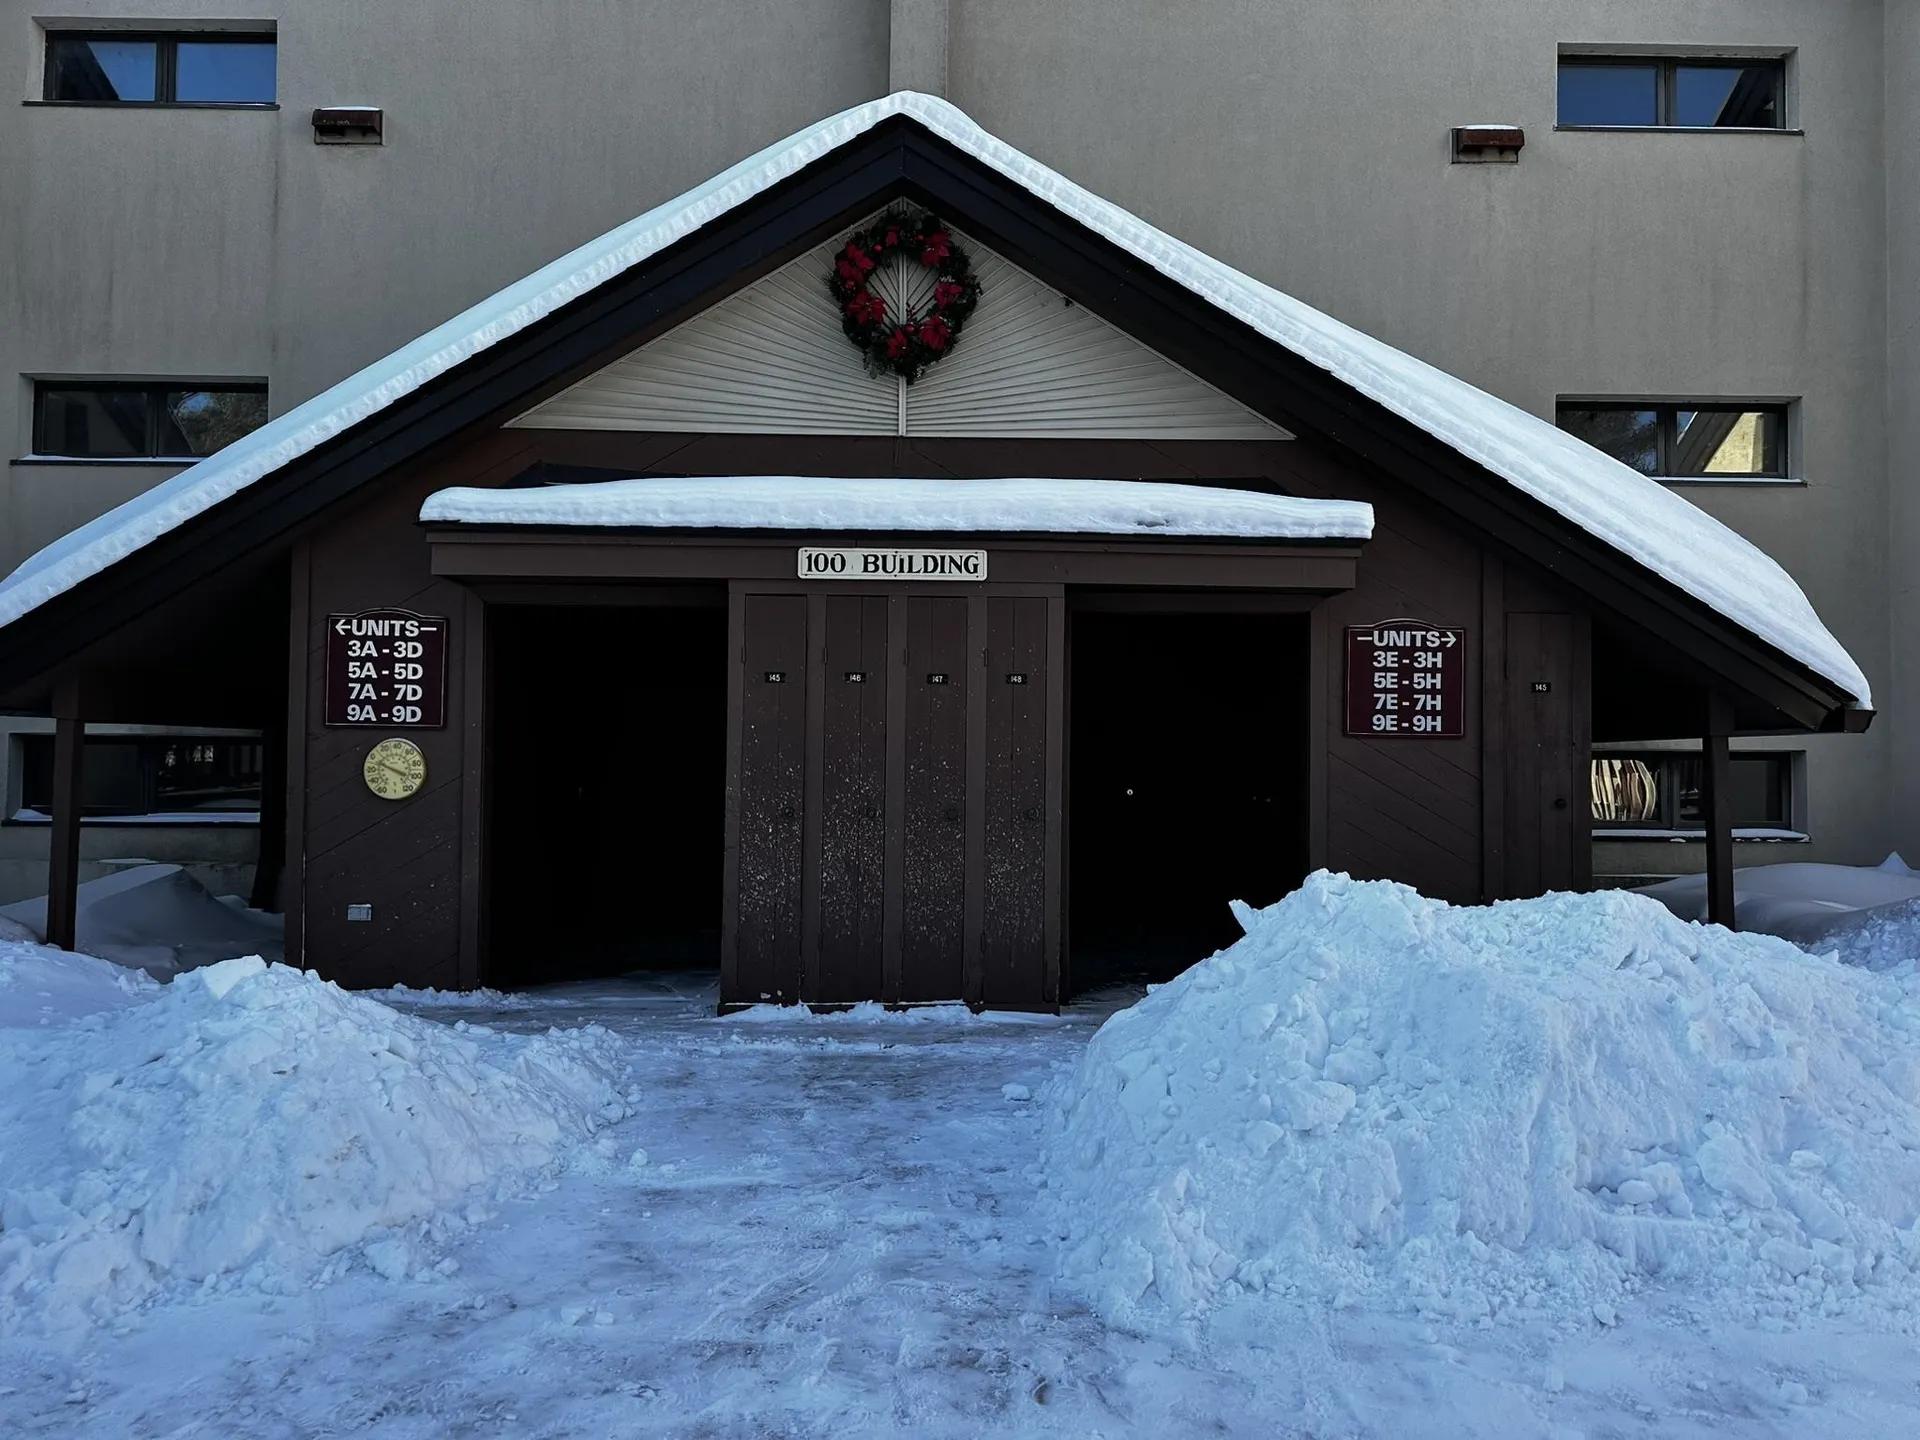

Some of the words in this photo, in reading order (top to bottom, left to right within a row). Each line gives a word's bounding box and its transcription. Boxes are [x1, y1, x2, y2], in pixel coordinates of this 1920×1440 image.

[805, 552, 846, 573] 100
[351, 619, 420, 637] UNITS
[1373, 630, 1441, 648] UNITS
[347, 640, 378, 658] 3A
[393, 641, 423, 659] 3D
[1372, 650, 1398, 668] 3E
[1413, 651, 1442, 668] 3H
[348, 662, 378, 679] 5A
[394, 663, 424, 680] 5D
[769, 673, 781, 682] 145
[849, 674, 862, 682] 146
[932, 675, 943, 683] 147
[1010, 675, 1022, 683] 148
[1373, 672, 1398, 689] 5E
[1412, 673, 1442, 689] 5H
[1535, 683, 1547, 692] 145
[348, 683, 377, 700] 7A
[393, 684, 423, 701] 7D
[1373, 693, 1398, 710] 7E
[1413, 694, 1442, 711] 7H
[346, 704, 377, 721] 9A
[392, 705, 422, 723] 9D
[1371, 714, 1398, 731] 9E
[1412, 715, 1442, 732] 9H
[405, 748, 414, 756] 60
